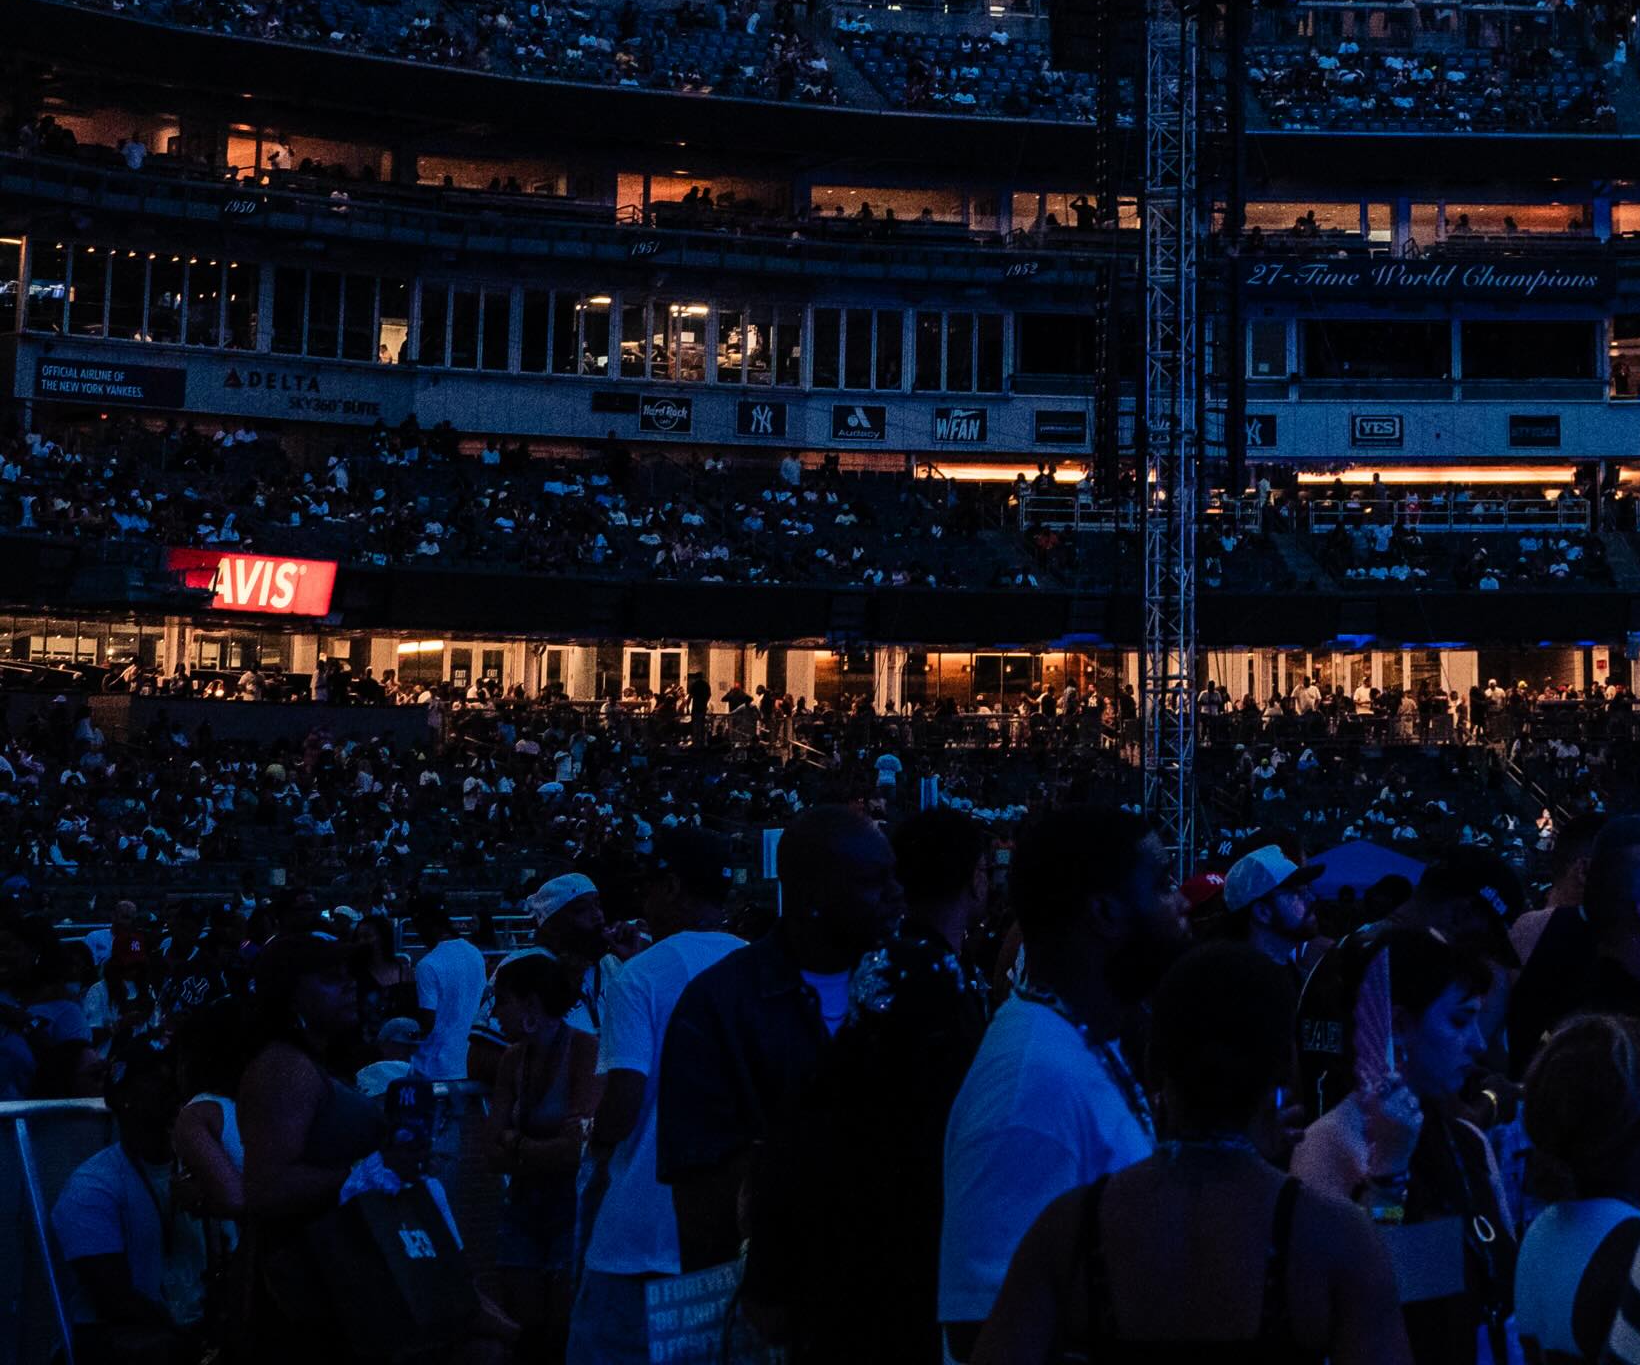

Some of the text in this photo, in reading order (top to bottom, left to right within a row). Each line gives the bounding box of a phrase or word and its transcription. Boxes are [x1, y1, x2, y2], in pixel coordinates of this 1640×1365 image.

[224, 200, 256, 214] 1950
[1246, 263, 1599, 296] 27-Time World Champions
[42, 365, 125, 382] OFFICIAL AIRLINE OF
[41, 379, 57, 392] THE
[59, 381, 80, 393] NEW
[81, 382, 107, 395] YORK
[250, 371, 320, 393] DELTA
[342, 400, 380, 416] SUITE
[642, 404, 688, 419] Hard Rock
[838, 428, 880, 439] Audacy
[1361, 421, 1394, 434] YES
[207, 557, 300, 609] AVIS
